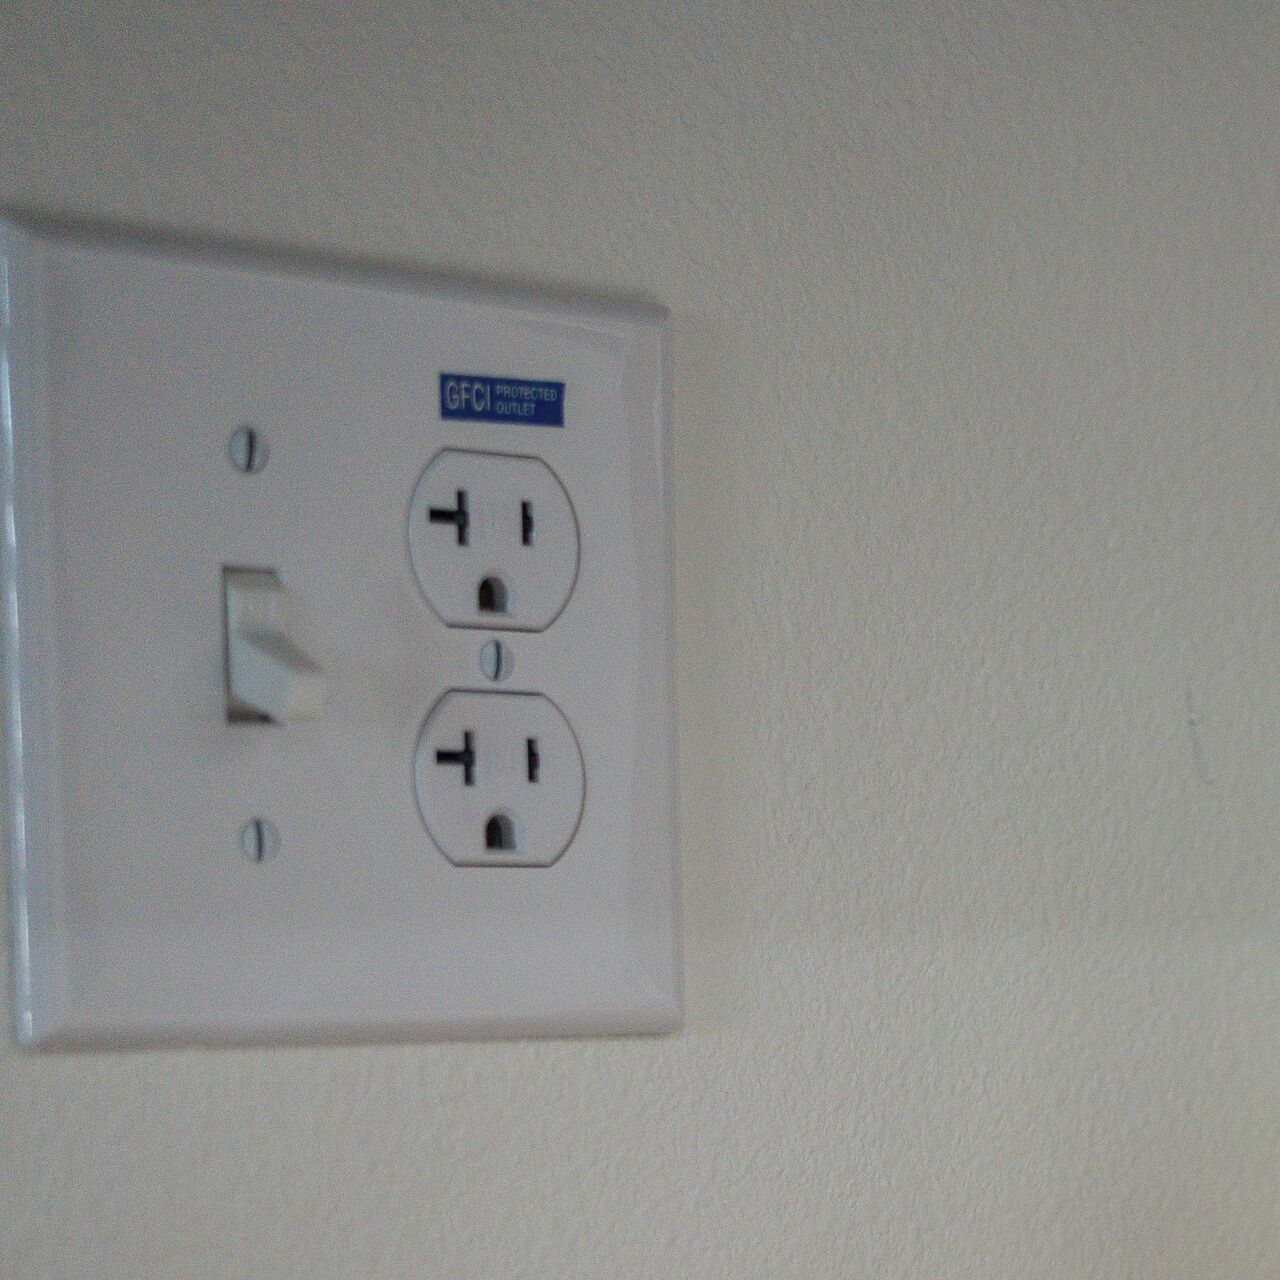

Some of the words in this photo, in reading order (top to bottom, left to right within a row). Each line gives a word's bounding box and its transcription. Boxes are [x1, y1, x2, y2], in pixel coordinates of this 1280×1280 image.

[447, 380, 491, 412] GFCI
[495, 385, 558, 401] PROTECTED
[496, 402, 535, 416] OUTLET
